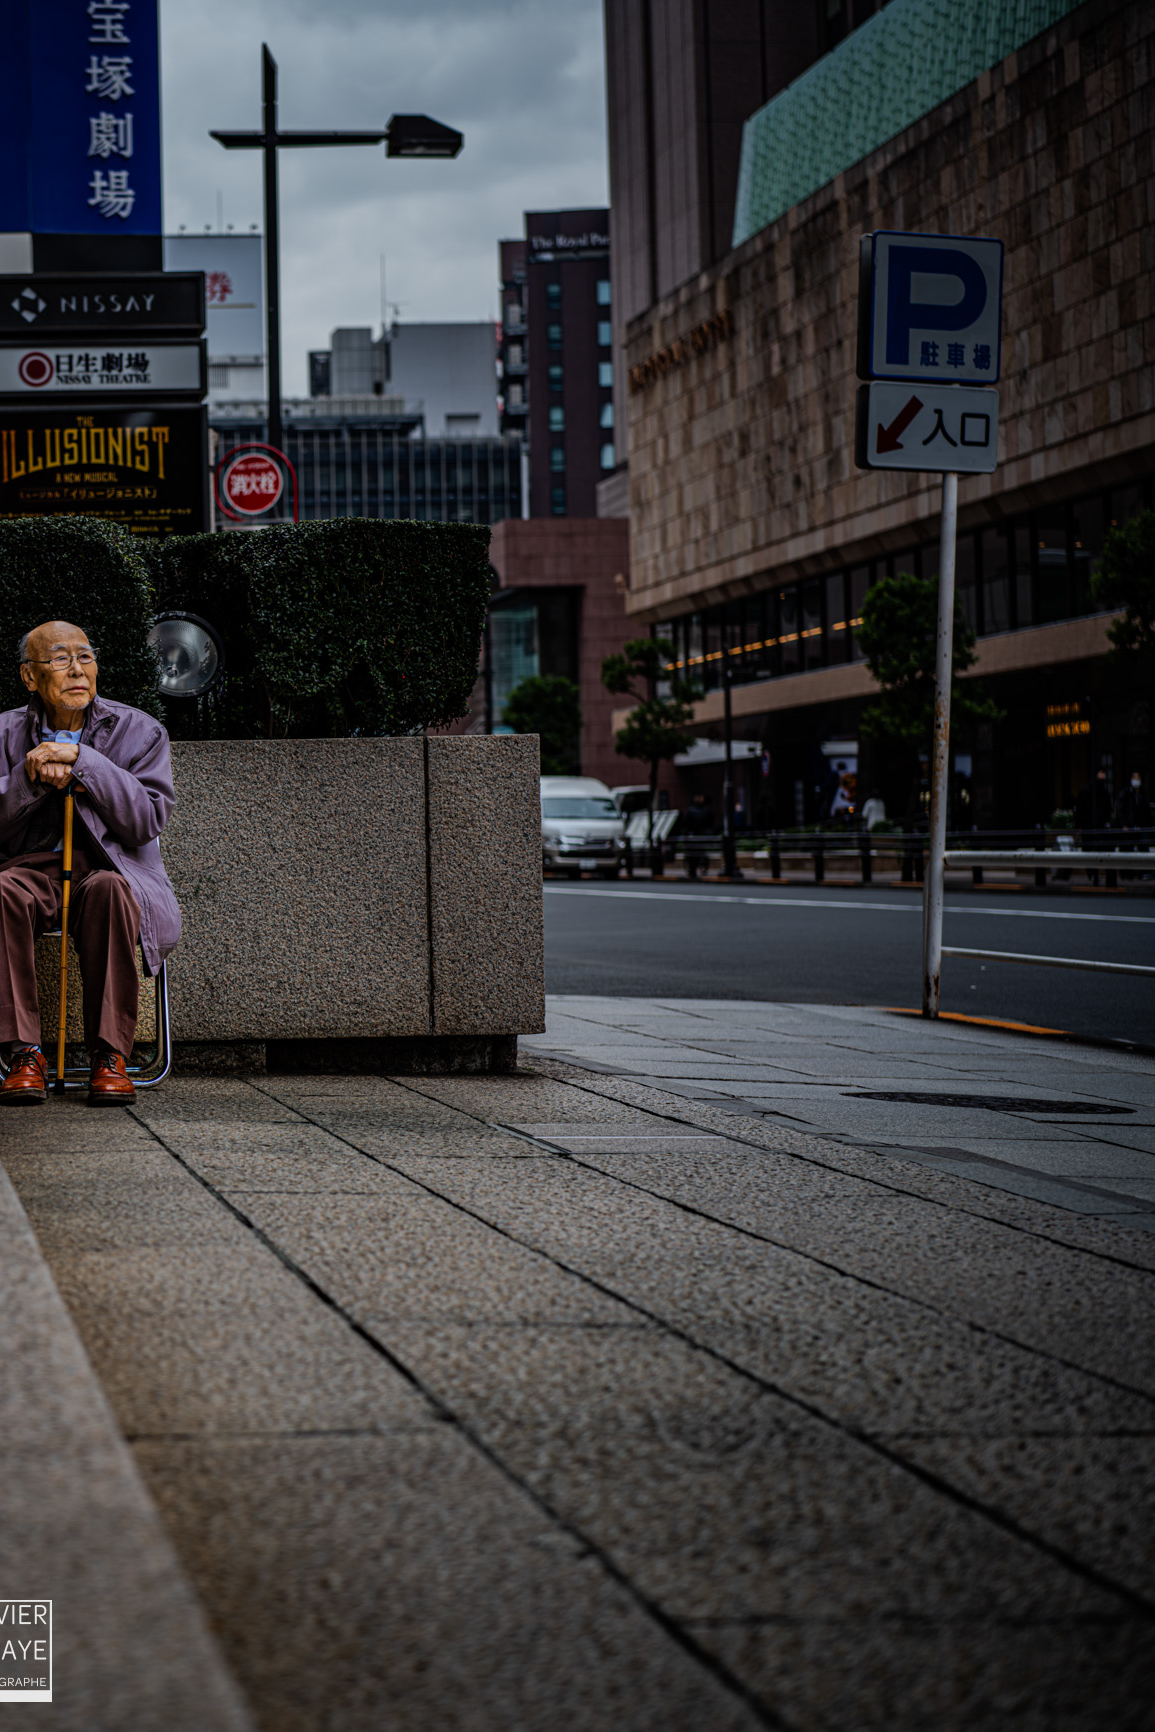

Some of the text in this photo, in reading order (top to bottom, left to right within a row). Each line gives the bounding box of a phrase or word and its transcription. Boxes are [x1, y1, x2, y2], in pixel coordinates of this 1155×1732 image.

[85, 0, 135, 219] 宝塚劇場
[555, 233, 588, 248] Royal
[60, 293, 156, 314] NISSAY
[886, 245, 987, 365] P
[55, 352, 150, 374] 日生劇場
[920, 341, 991, 370] 駐車場
[55, 372, 151, 385] NISSAY THEATRE
[75, 415, 95, 428] THE
[922, 409, 990, 447] 入口
[0, 425, 171, 484] ILLUSIONIST
[83, 471, 119, 483] MUSICAL
[229, 471, 277, 497] 消火栓
